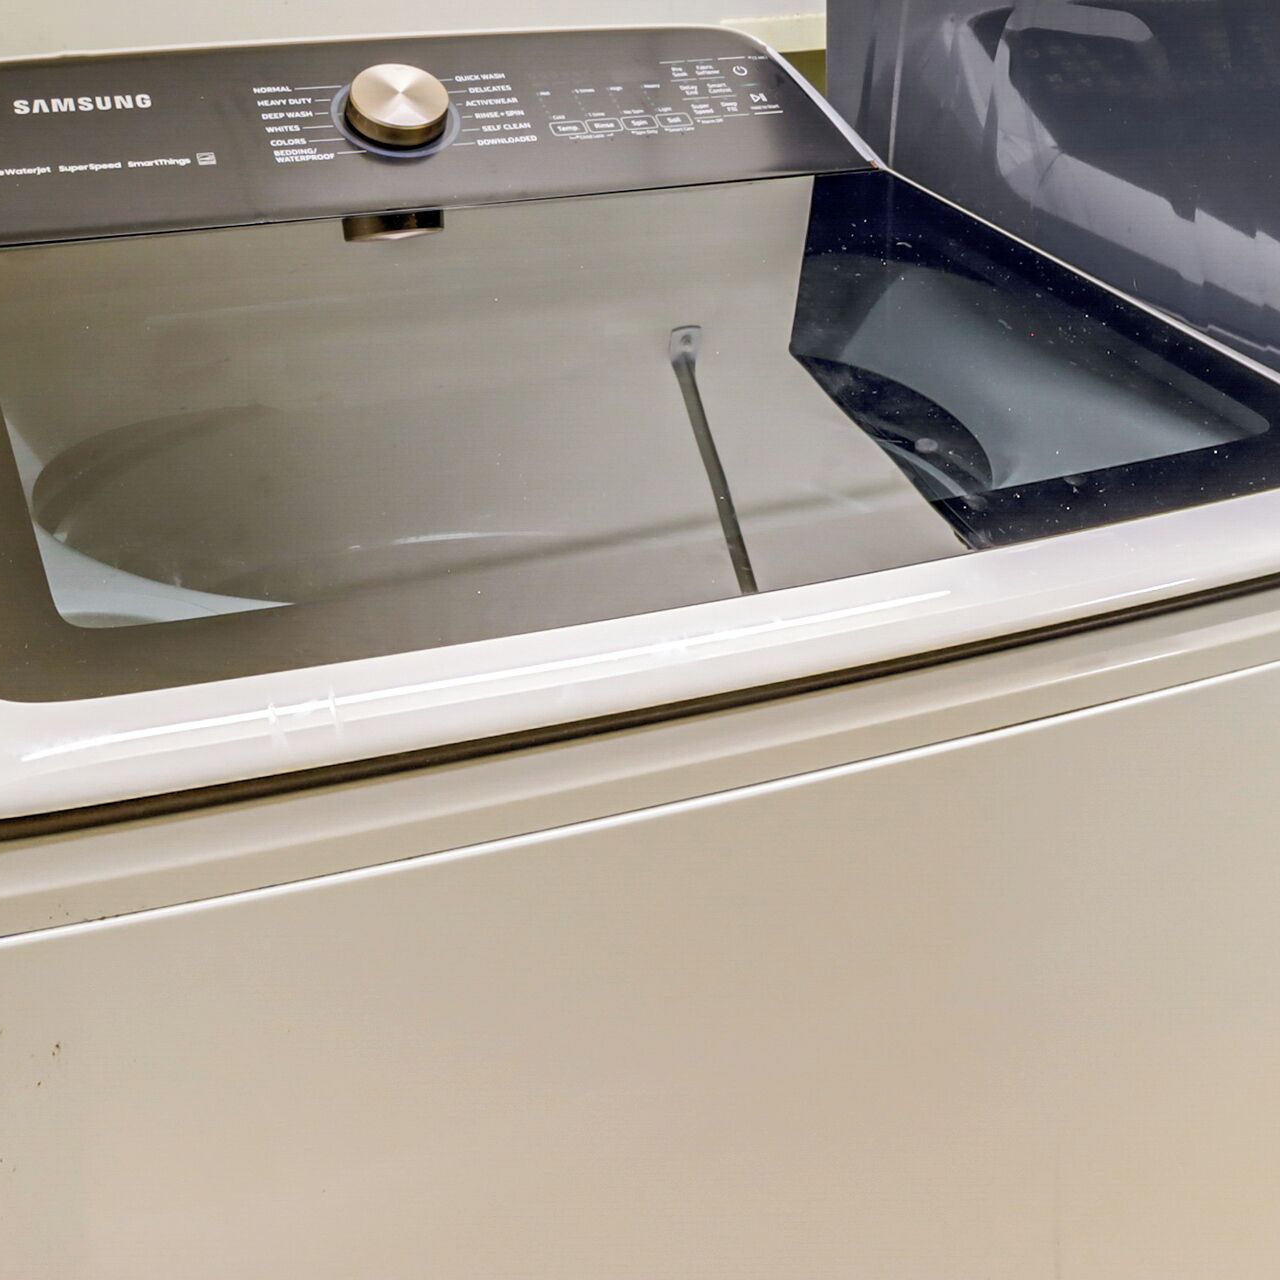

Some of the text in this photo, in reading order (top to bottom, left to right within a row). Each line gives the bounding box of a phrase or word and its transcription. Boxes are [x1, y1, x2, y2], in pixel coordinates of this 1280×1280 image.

[454, 74, 480, 82] QUICK
[253, 86, 292, 94] NORMAL
[468, 85, 512, 94] DELICATES
[13, 94, 152, 115] SAMSUNG
[257, 99, 287, 107] HEAVY
[466, 97, 519, 107] ACTIVEWEAR
[262, 112, 285, 120] DEEP
[631, 119, 649, 127] Spin
[265, 125, 301, 133] WHITES
[482, 122, 531, 133] SELF CLEAN
[270, 138, 307, 146] COLORS
[477, 135, 538, 146] DOWNLOADED
[274, 148, 317, 156] BEDDING/
[275, 153, 335, 163] WATERPROOF
[128, 158, 191, 168] SmartThings
